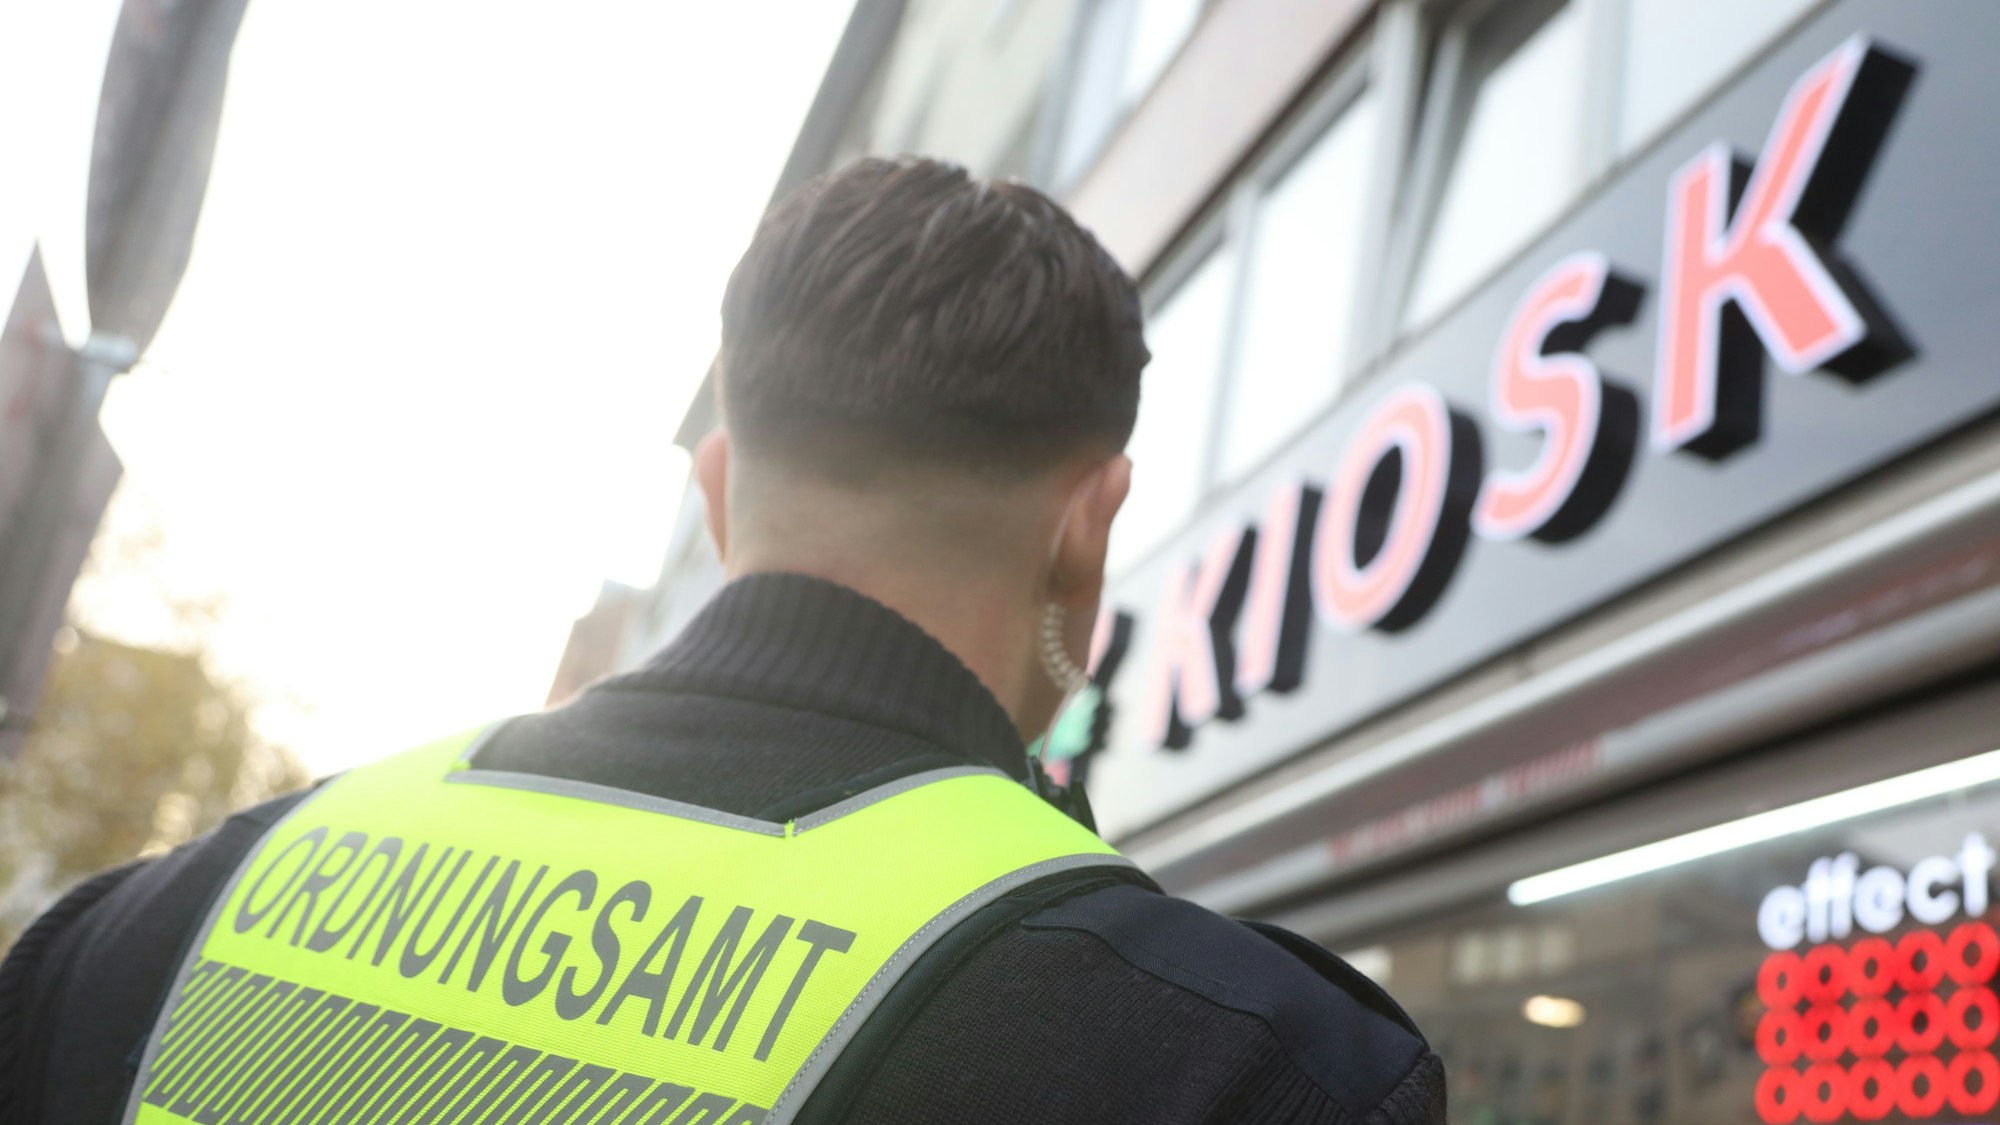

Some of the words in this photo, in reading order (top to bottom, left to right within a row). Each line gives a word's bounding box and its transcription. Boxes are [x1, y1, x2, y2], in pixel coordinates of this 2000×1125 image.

[1146, 30, 1920, 752] KIOSK
[234, 825, 857, 1062] ORDNUNGSAMT
[1757, 832, 1995, 950] effect
